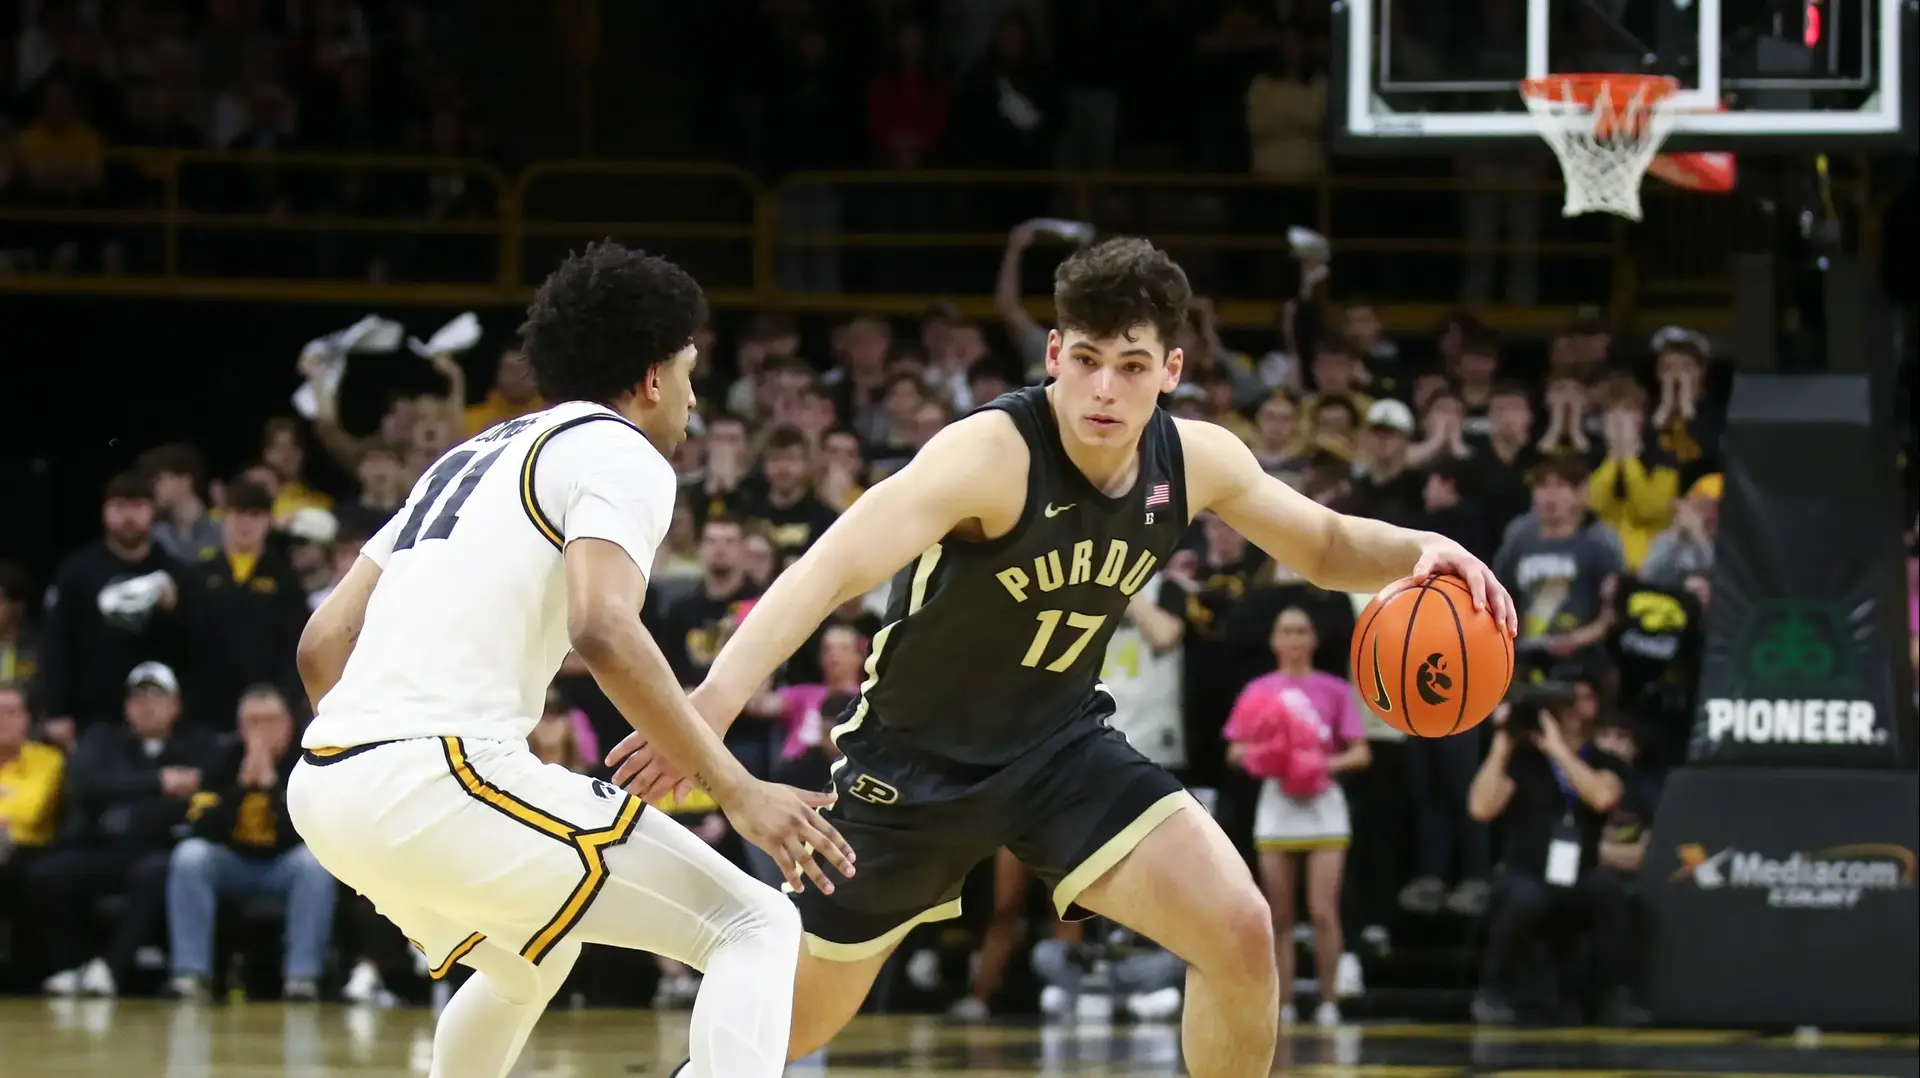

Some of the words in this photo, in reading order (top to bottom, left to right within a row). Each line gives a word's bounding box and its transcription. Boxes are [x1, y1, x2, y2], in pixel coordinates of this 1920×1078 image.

[393, 441, 511, 553] 11
[995, 539, 1158, 603] PURDU
[1020, 609, 1108, 673] 17
[1706, 698, 1876, 743] PIONEER
[848, 773, 899, 804] P
[1729, 851, 1899, 889] Mediacom
